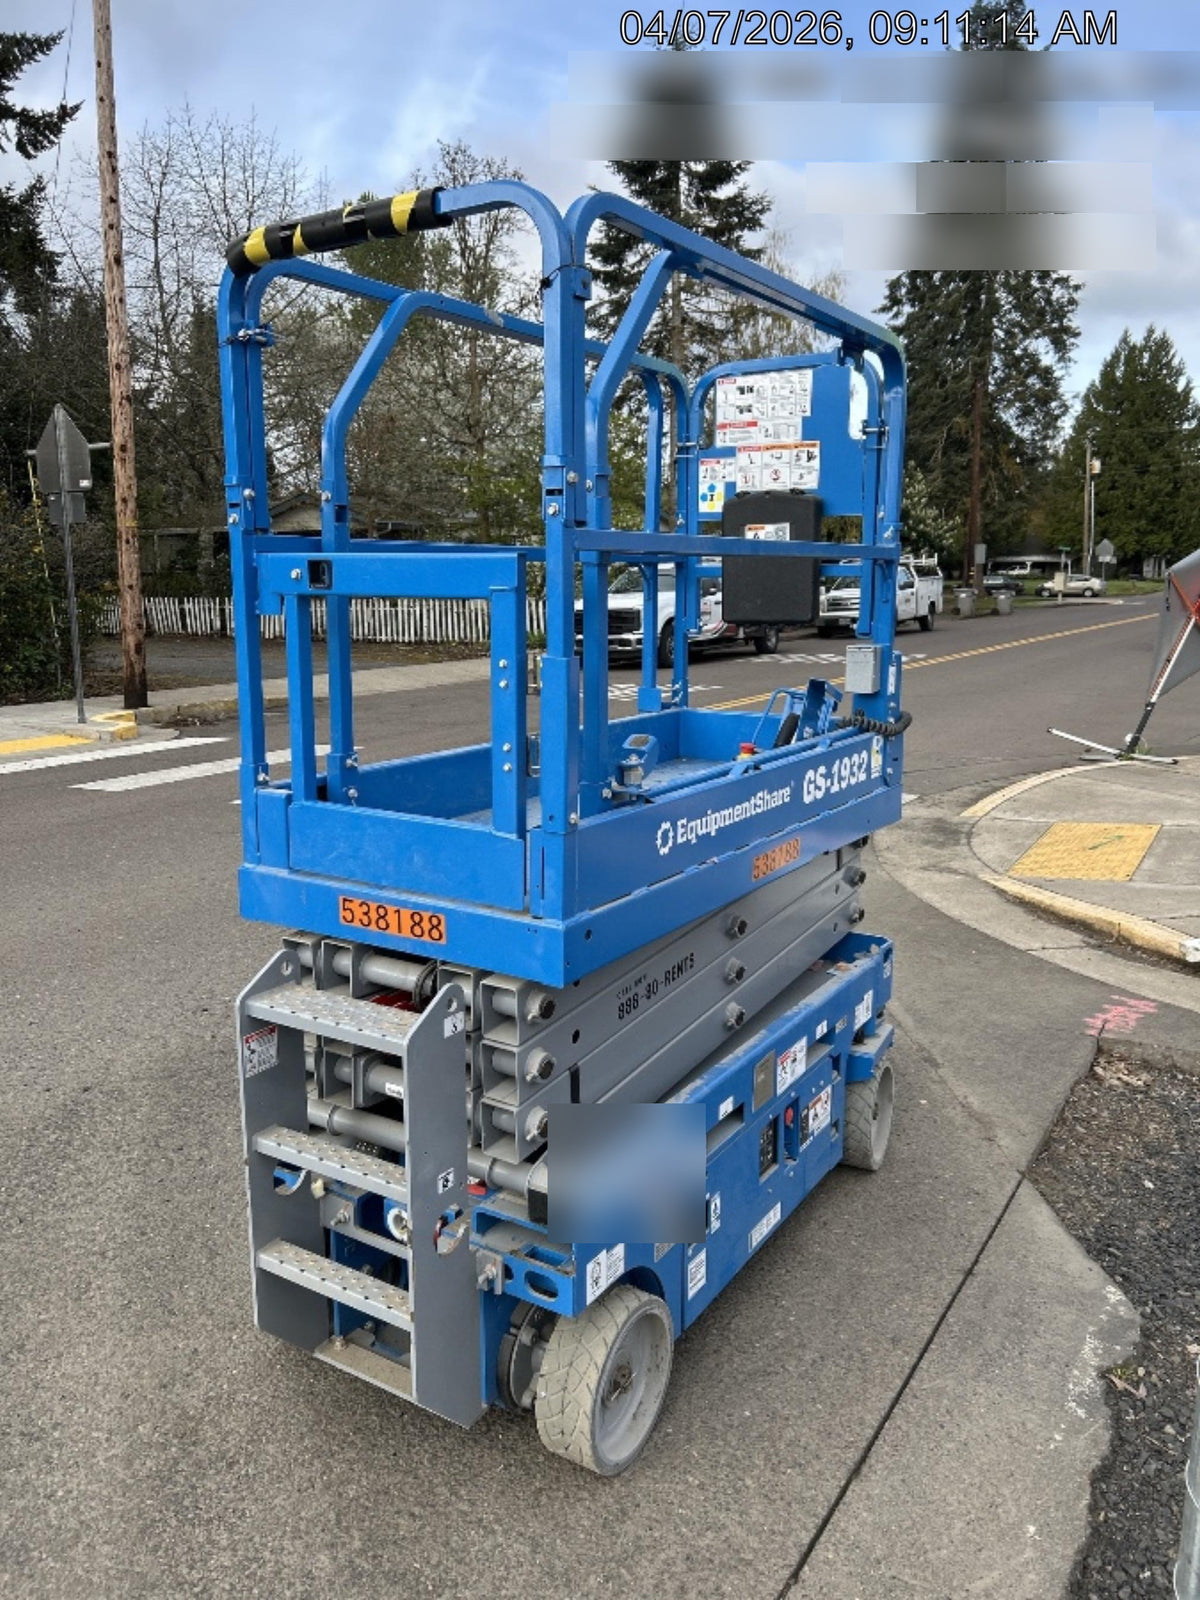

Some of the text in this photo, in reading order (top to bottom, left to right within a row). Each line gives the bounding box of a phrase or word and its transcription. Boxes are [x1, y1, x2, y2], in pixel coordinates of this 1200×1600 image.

[676, 750, 869, 845] EquipmentShare GS-1932
[341, 897, 444, 941] 538188
